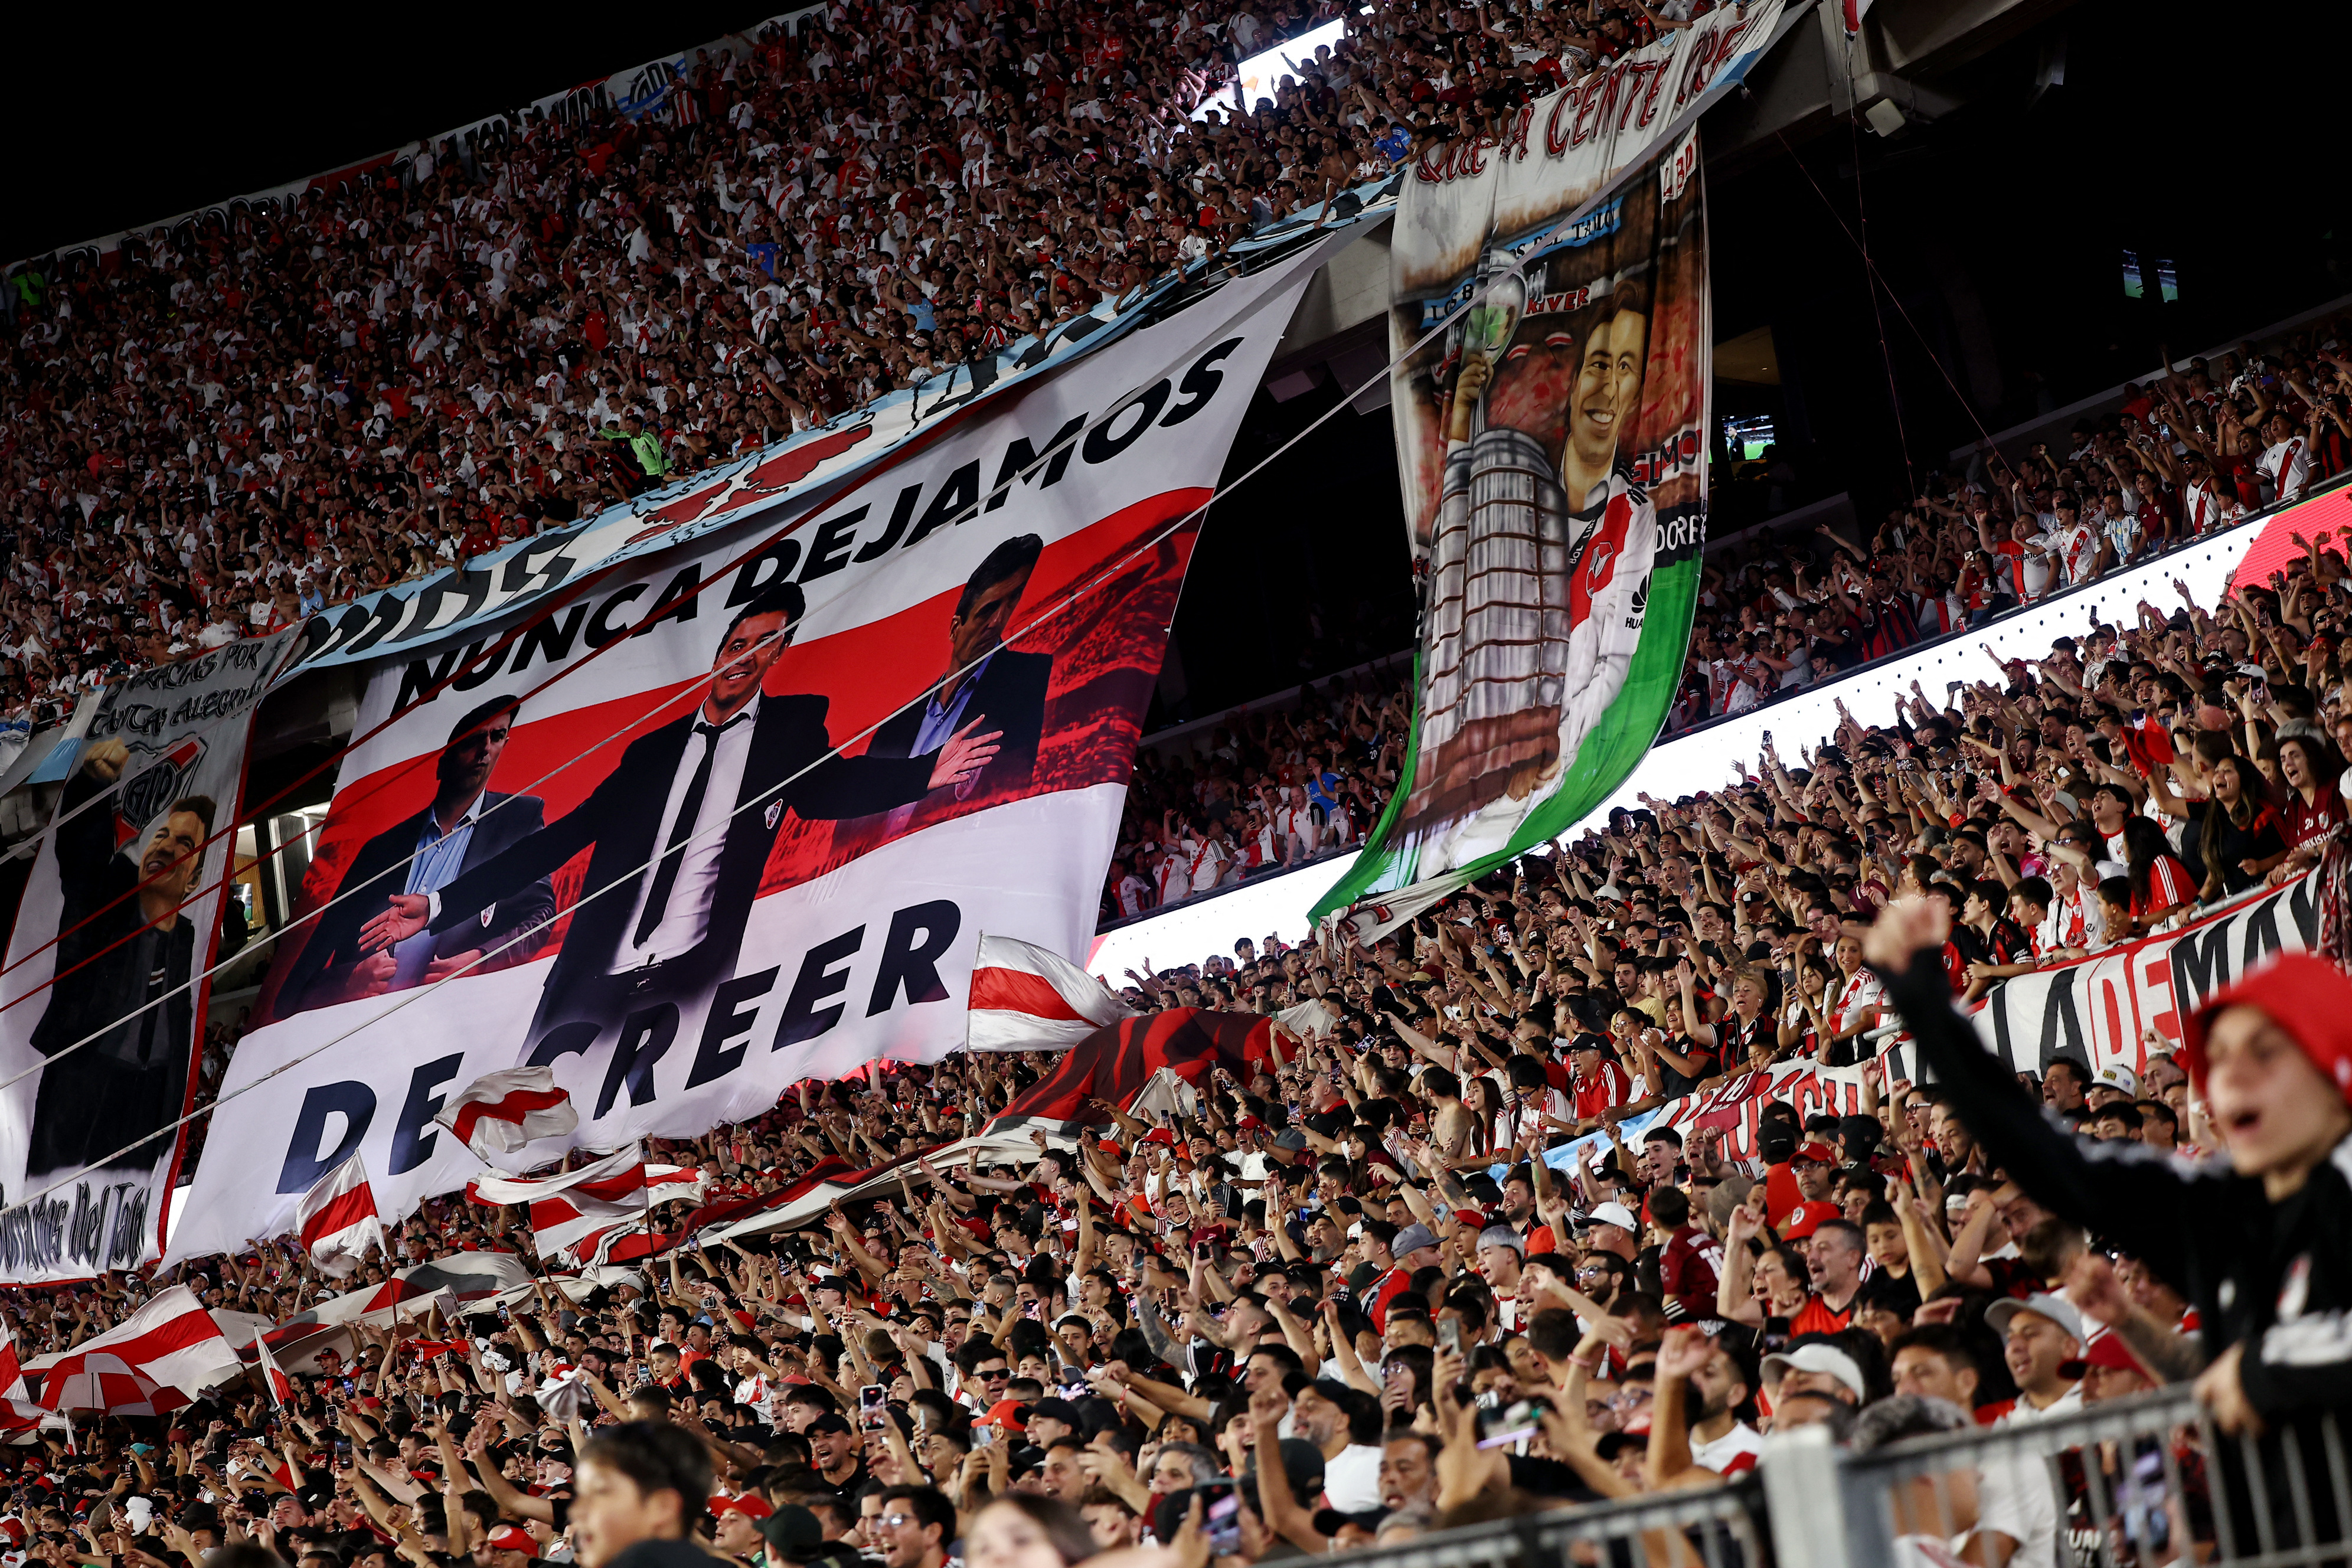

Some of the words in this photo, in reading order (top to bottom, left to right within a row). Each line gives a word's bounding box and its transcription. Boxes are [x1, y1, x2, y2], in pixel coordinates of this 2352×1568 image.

[1526, 287, 1590, 315] RIVER
[1633, 430, 1698, 488] ELMO
[389, 561, 702, 718] NUNCA
[724, 337, 1245, 610] DEJAMOS
[1655, 514, 1705, 554] DORE
[1570, 545, 1583, 564] BOL
[1625, 617, 1644, 629] HUA
[219, 641, 266, 674] POR
[2064, 923, 2095, 948] odere
[276, 1051, 465, 1195] DE
[570, 899, 965, 1121] REER
[1801, 1027, 1817, 1037] etan
[1719, 1068, 1756, 1102] 10
